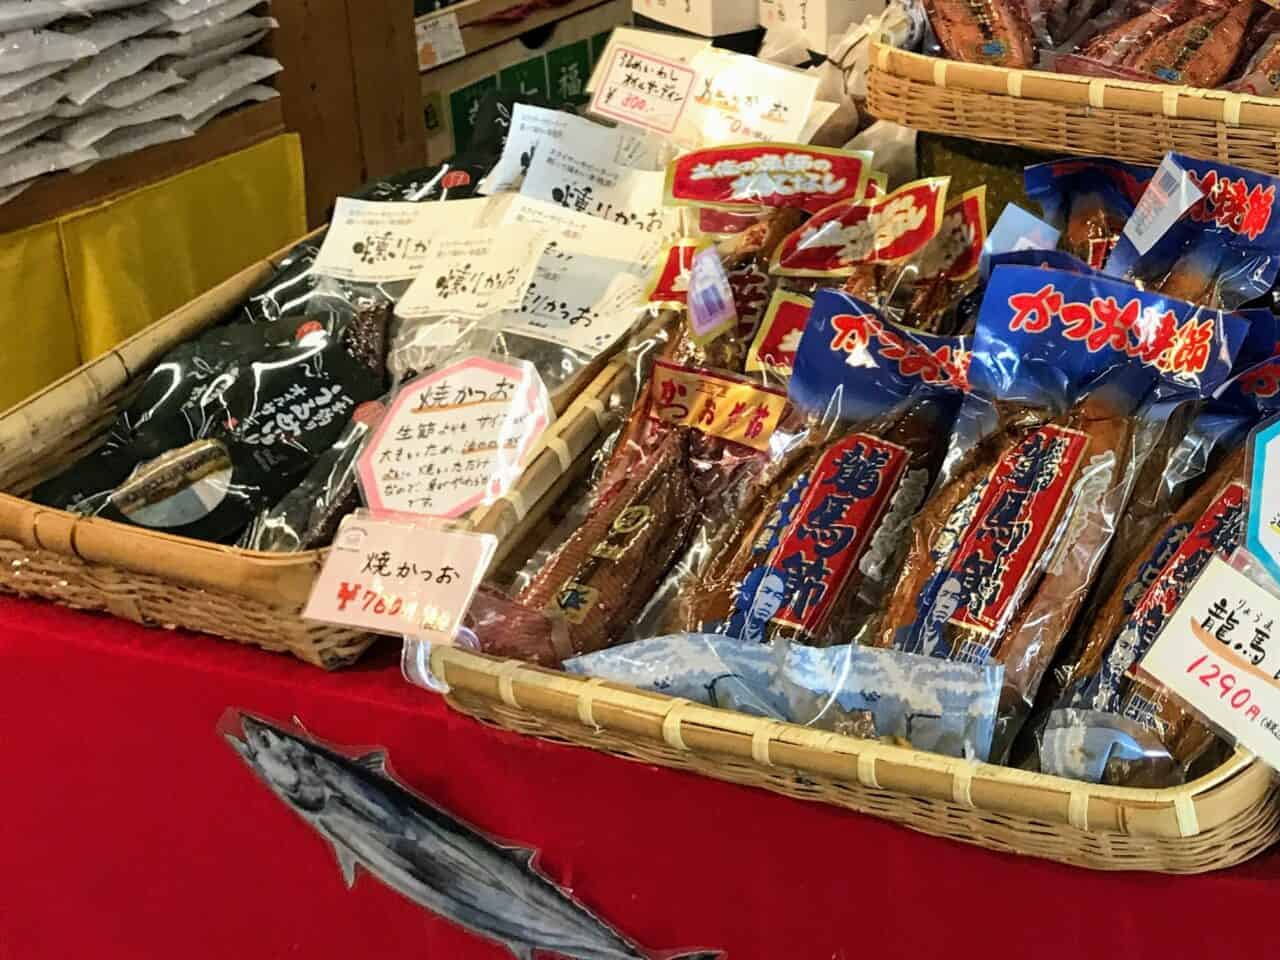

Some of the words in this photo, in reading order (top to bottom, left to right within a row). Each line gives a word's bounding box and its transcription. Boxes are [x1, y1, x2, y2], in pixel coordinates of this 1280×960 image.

[1008, 283, 1214, 375] かつお焼節
[361, 551, 461, 585] 焼かつお
